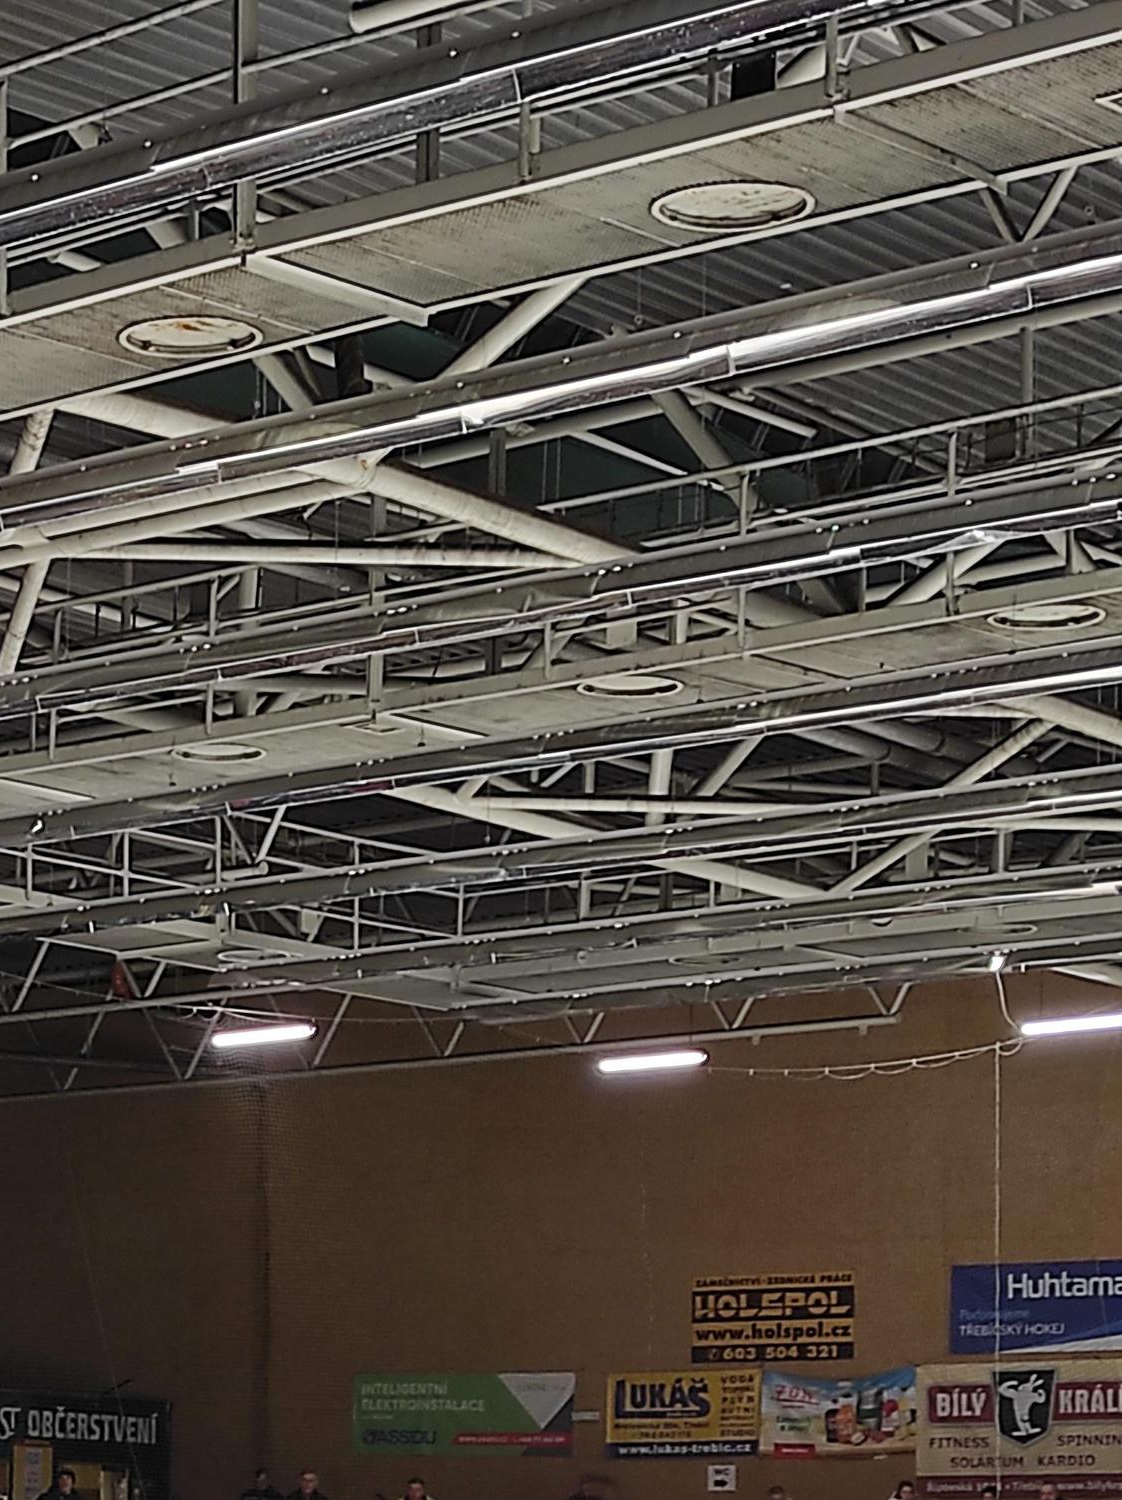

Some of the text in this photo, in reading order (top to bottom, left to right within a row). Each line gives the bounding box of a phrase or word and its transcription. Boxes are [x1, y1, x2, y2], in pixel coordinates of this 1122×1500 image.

[695, 1321, 852, 1342] www.holspol.cz
[722, 1344, 839, 1360] 603 504 321
[615, 1377, 711, 1419] LUKÁŠ
[935, 1388, 987, 1417] BÍLÝ
[27, 1406, 159, 1445] OBČERSTVENÍ
[929, 1436, 990, 1449] FITNESS
[1038, 1454, 1096, 1467] KARDIO
